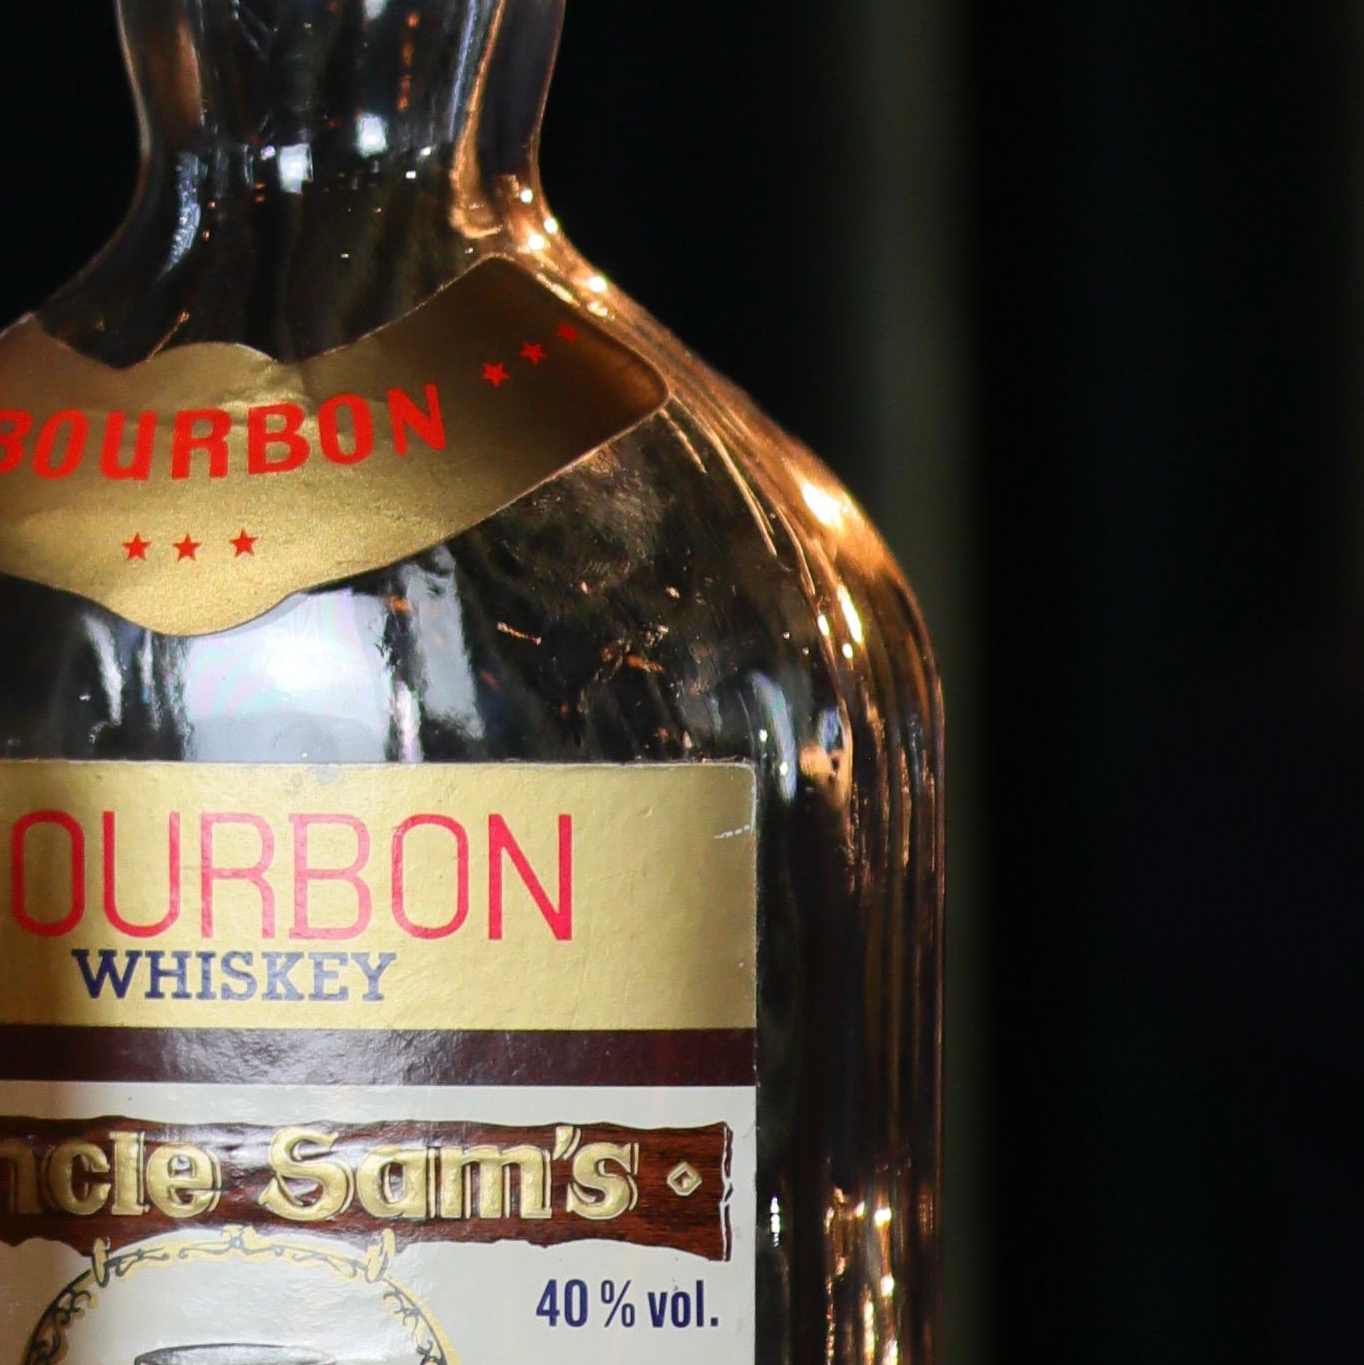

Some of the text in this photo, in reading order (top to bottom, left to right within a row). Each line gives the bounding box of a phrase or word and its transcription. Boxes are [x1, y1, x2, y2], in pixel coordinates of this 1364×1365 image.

[72, 948, 396, 1002] WHISKEY
[259, 1123, 640, 1220] Sam's
[647, 1277, 721, 1328] vol.
